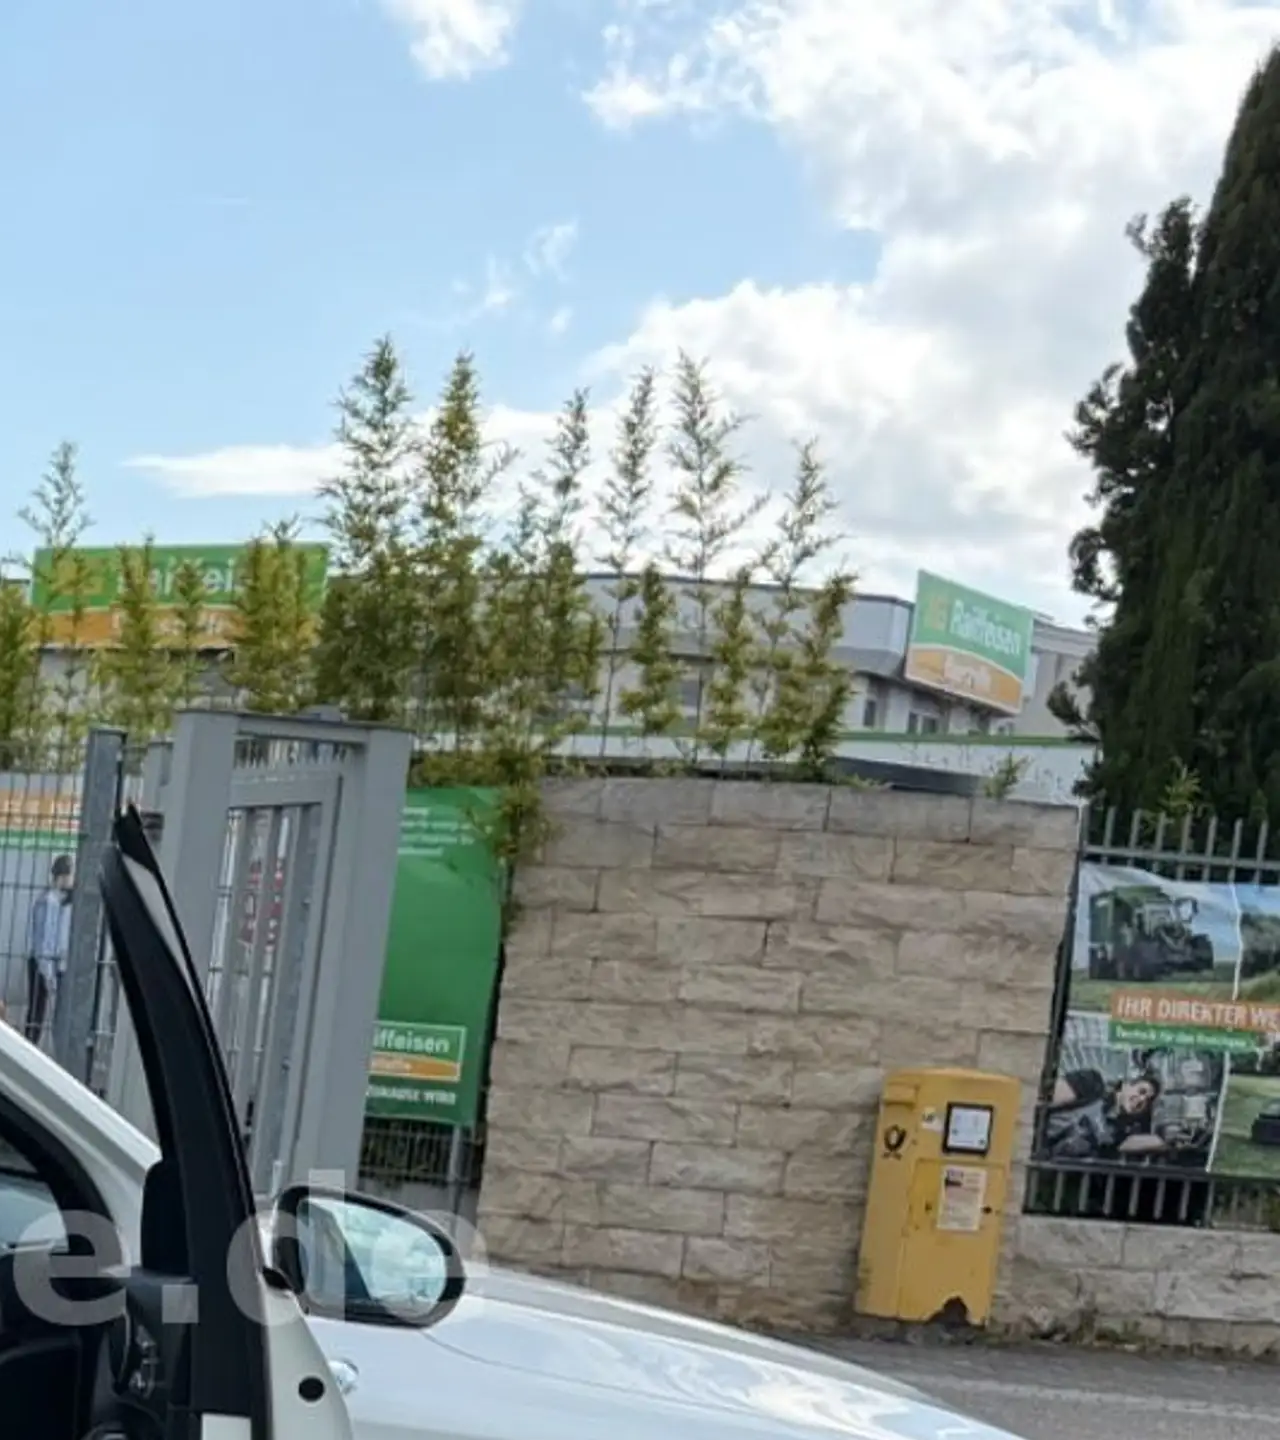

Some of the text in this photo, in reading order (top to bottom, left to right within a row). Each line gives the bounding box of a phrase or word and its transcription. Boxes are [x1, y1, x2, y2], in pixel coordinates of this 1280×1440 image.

[1117, 996, 1153, 1019] IHR
[1157, 998, 1246, 1027] DIREKTER
[373, 1026, 451, 1053] iffeisen
